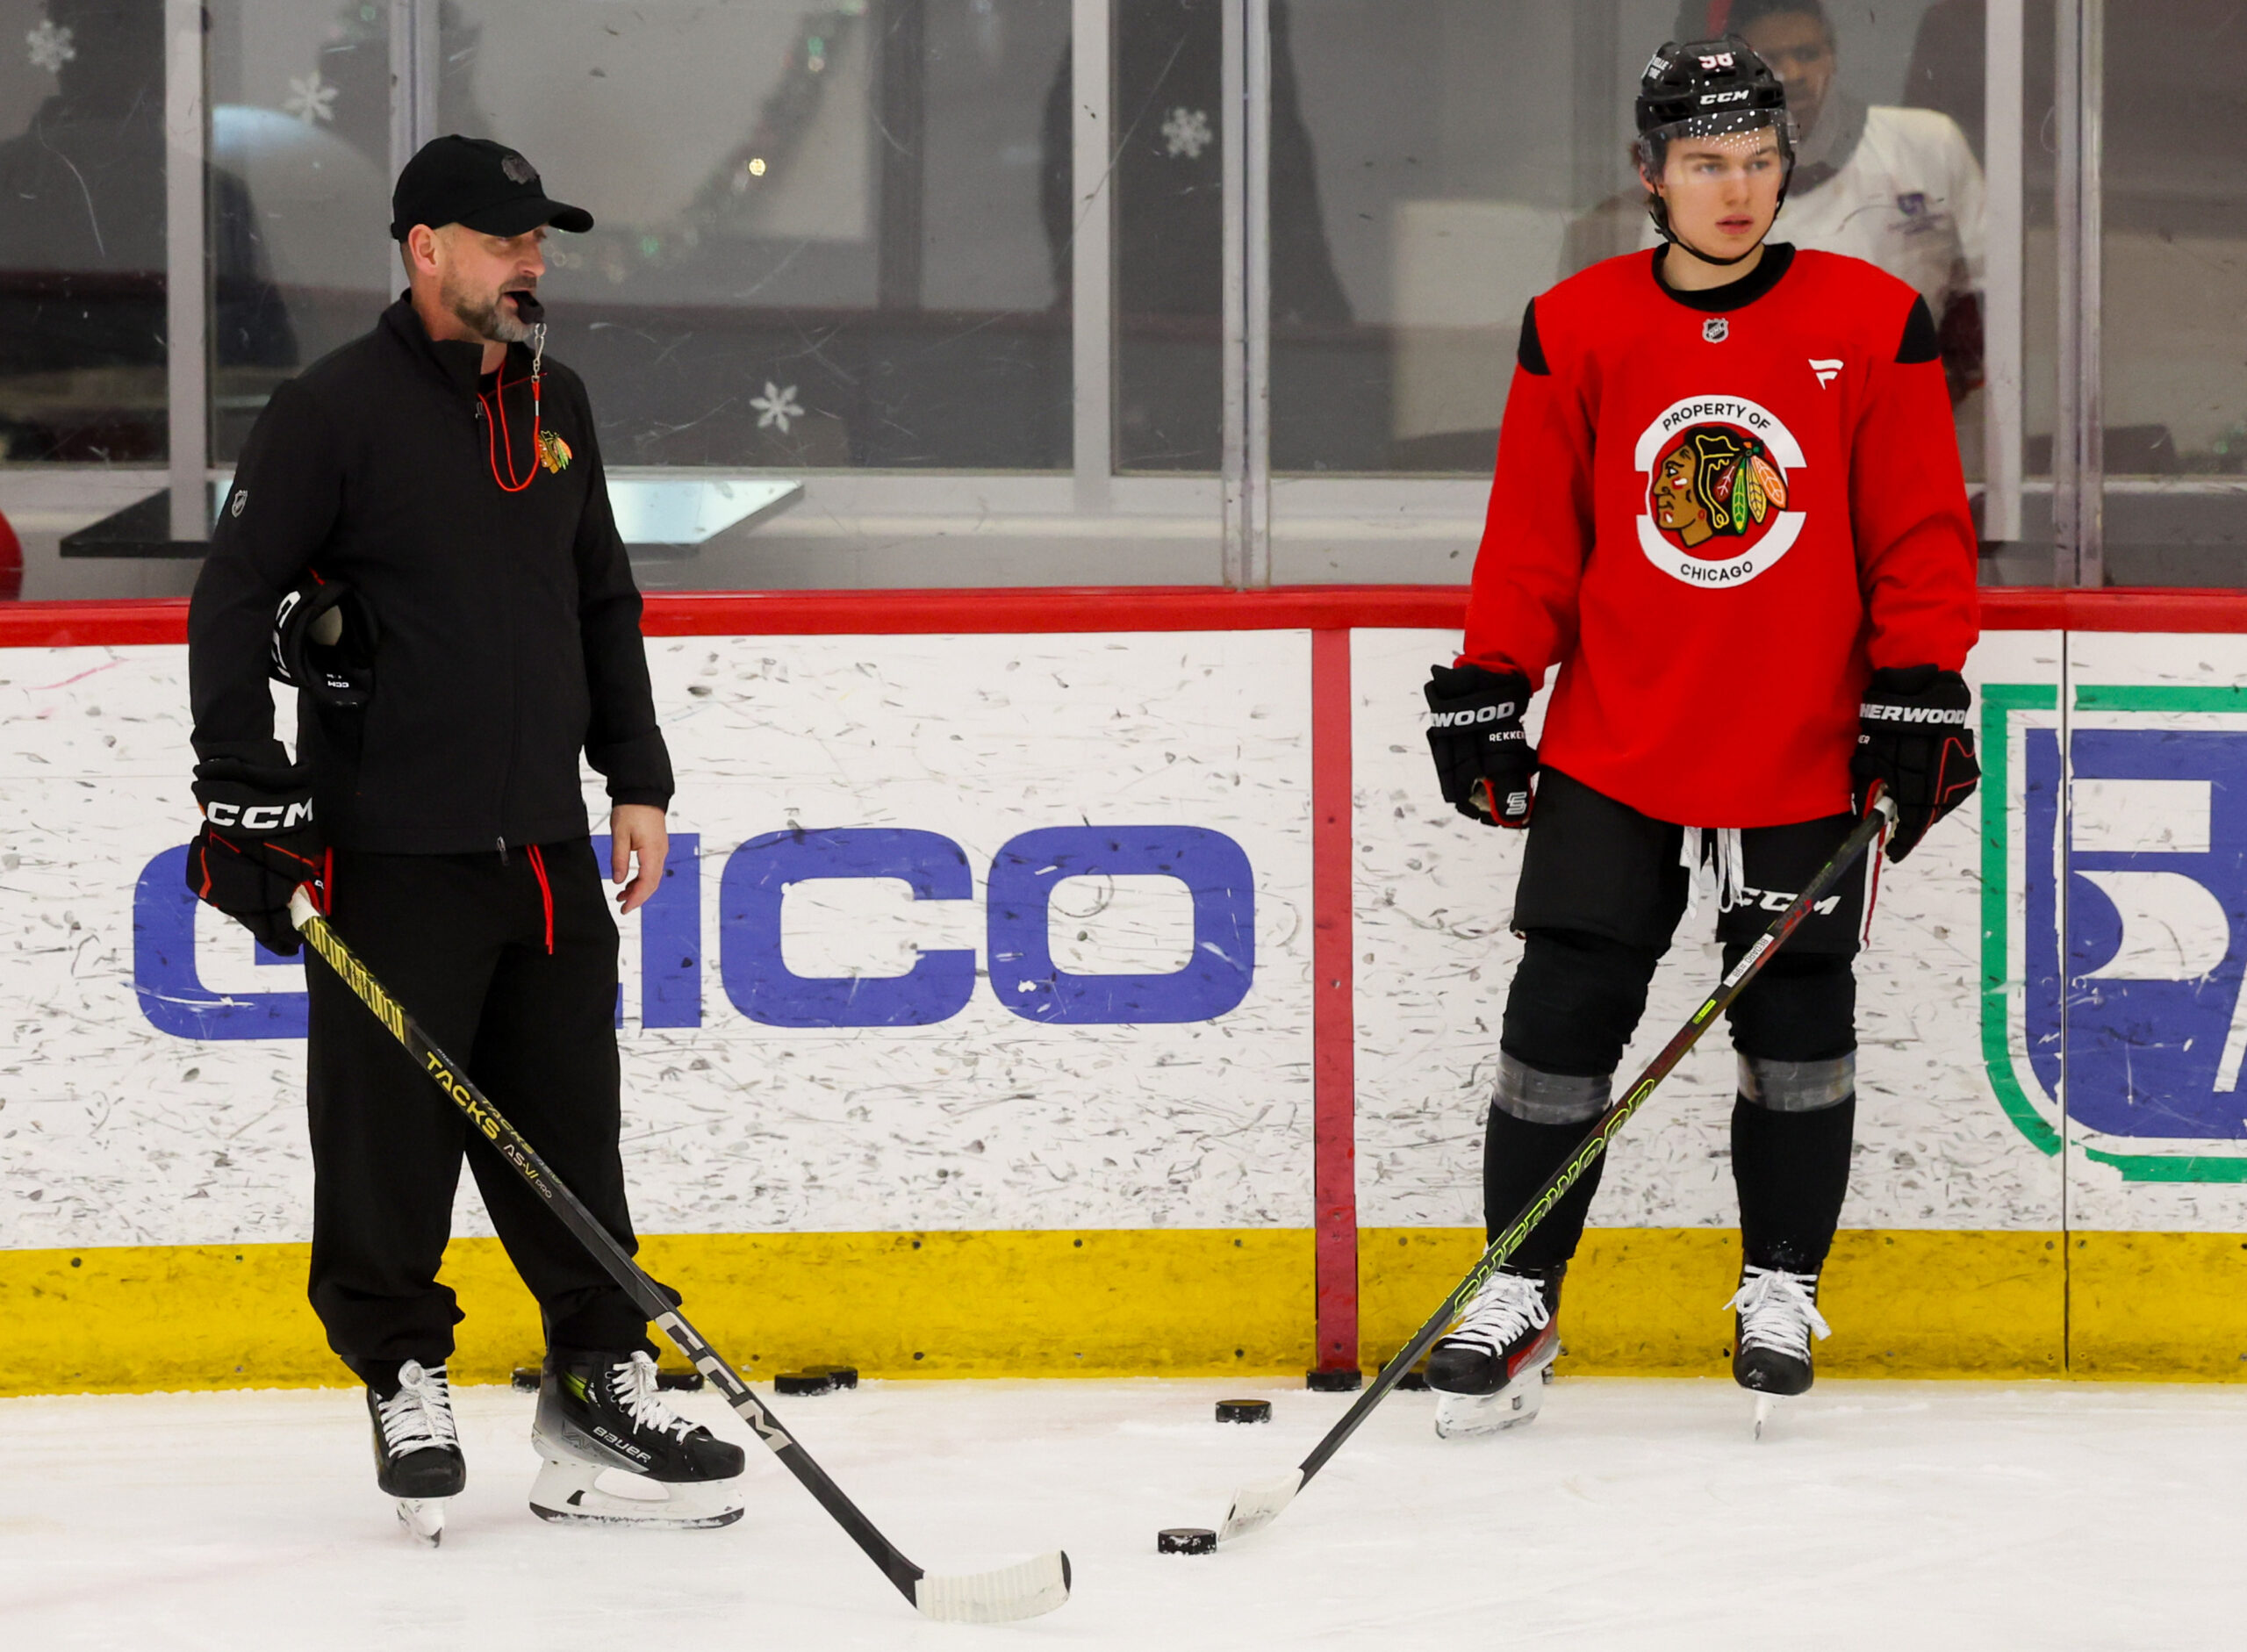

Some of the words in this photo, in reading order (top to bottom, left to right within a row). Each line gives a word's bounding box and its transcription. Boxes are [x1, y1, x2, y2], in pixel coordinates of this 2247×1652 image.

[1699, 90, 1749, 105] CCM
[1662, 403, 1747, 431] PROPERTY
[1748, 413, 1771, 430] OF
[1680, 561, 1754, 581] CHICAGO
[206, 797, 313, 829] CCM
[133, 825, 1255, 1041] GICO
[427, 1051, 501, 1140] TACKS
[535, 1179, 553, 1199] PRO
[655, 1311, 793, 1453] CCM
